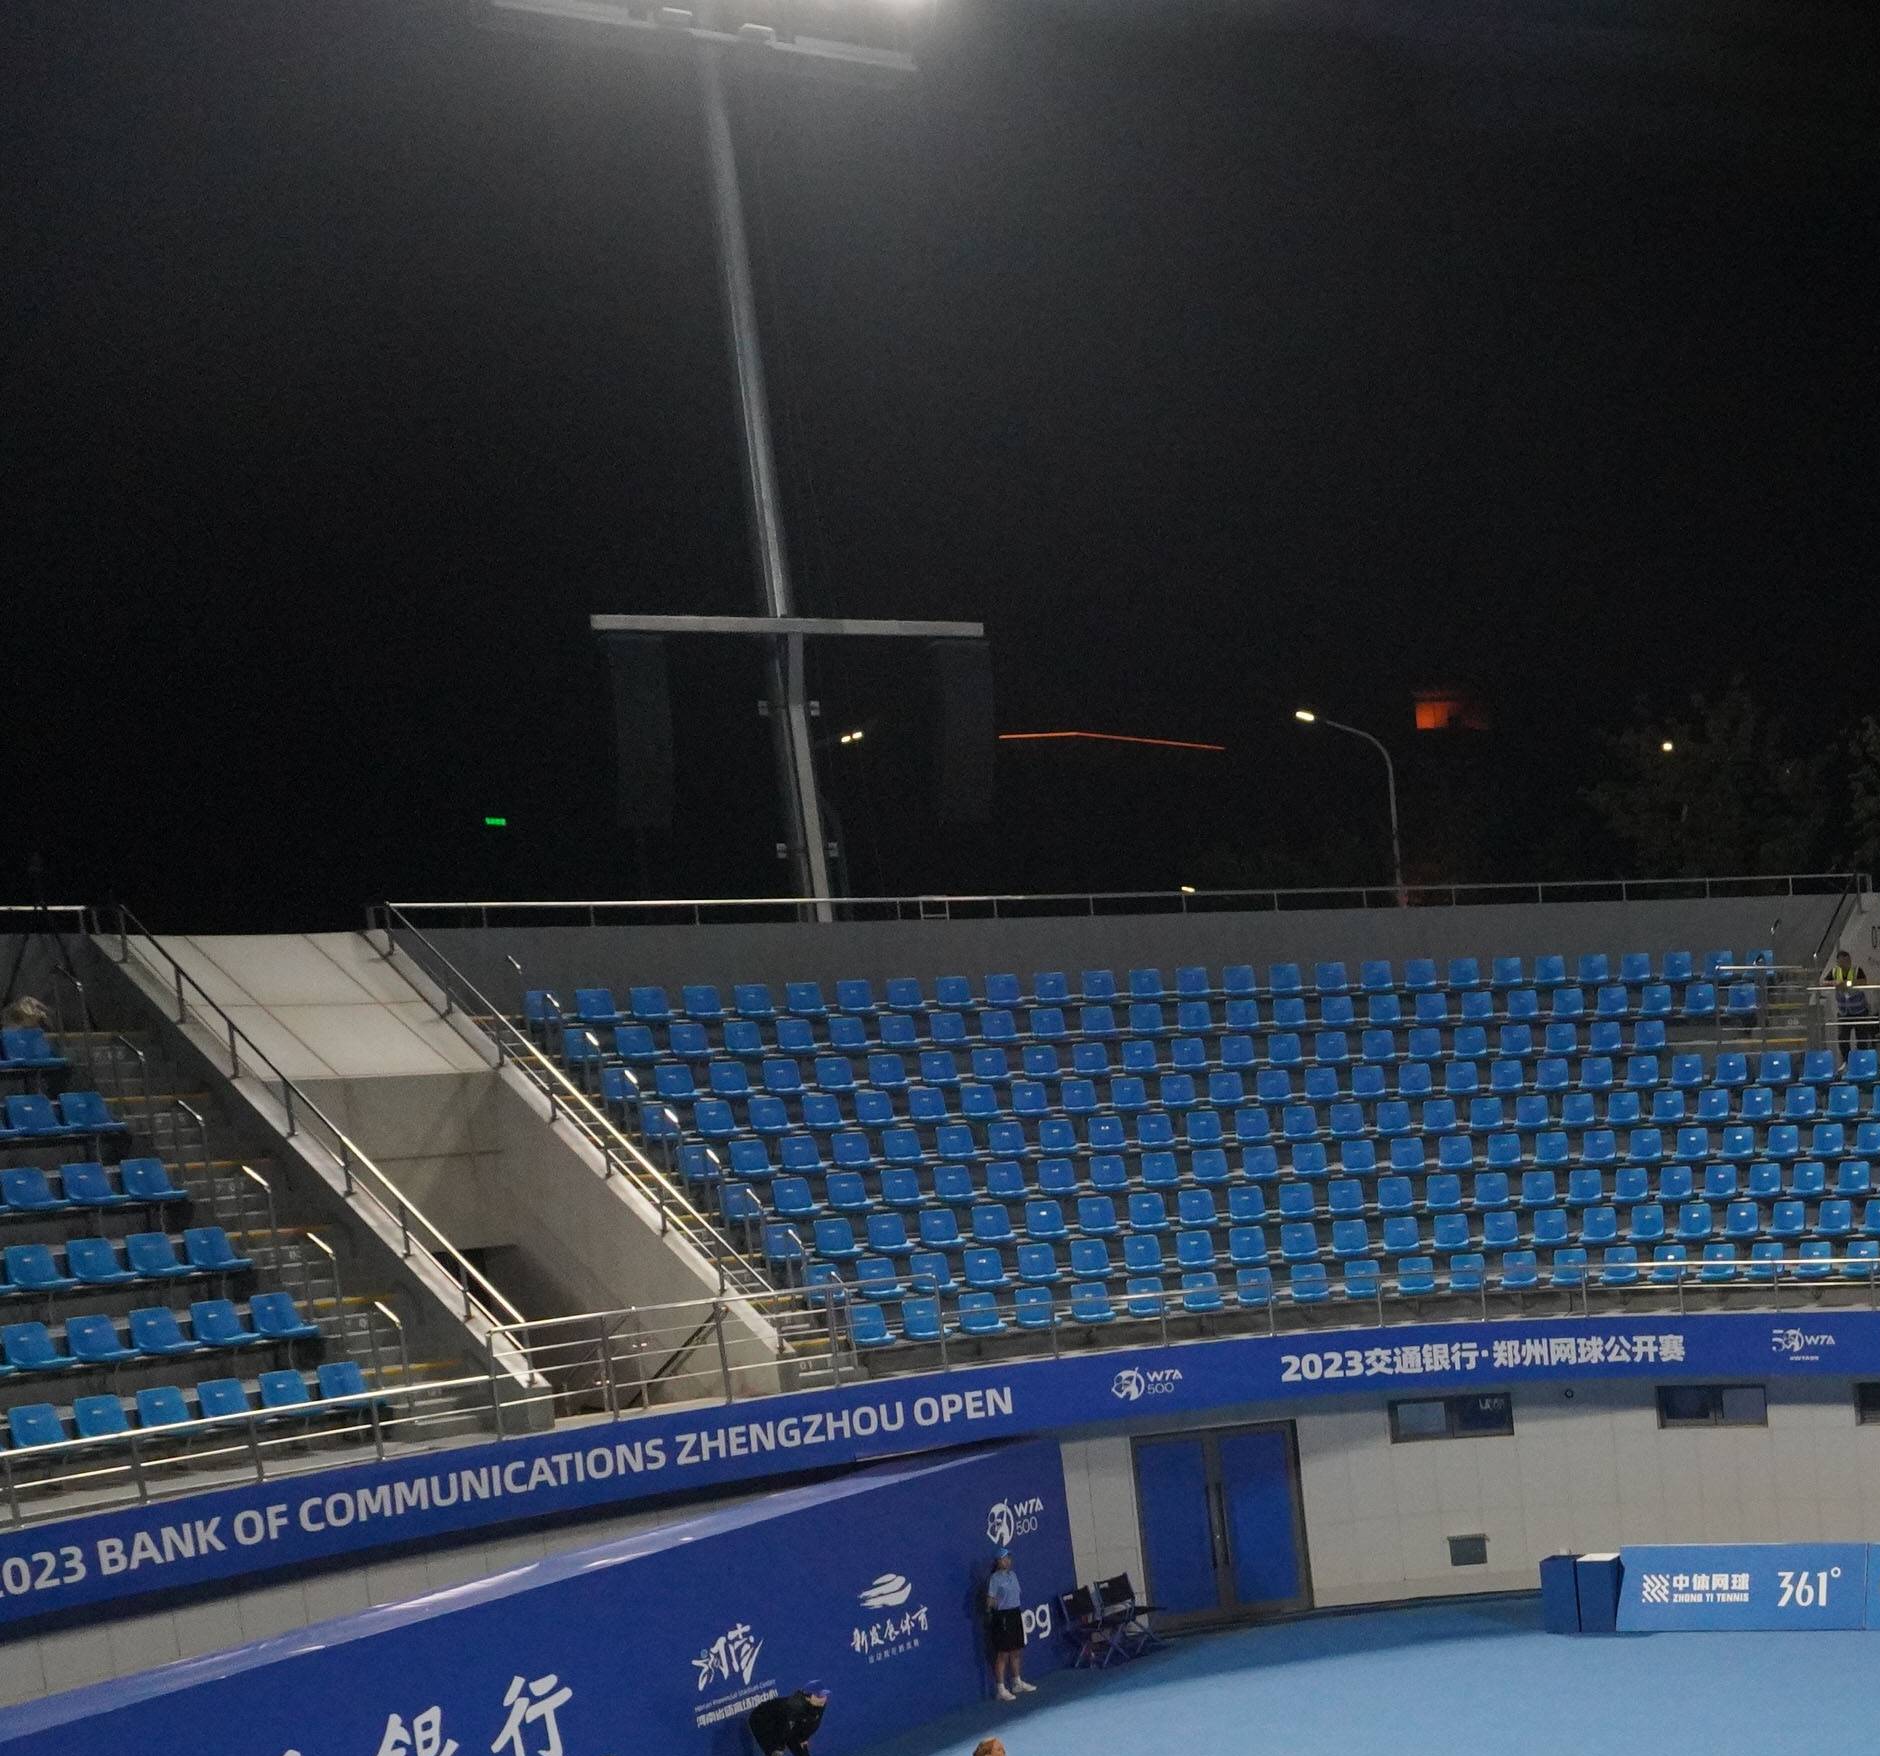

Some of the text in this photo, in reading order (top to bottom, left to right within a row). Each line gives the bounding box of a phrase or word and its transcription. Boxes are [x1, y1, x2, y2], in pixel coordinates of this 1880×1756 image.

[1804, 1334, 1836, 1345] WTA
[1277, 1330, 1686, 1382] 2023交通银行·郑州网球公开赛
[1146, 1369, 1183, 1383] WTA
[1147, 1382, 1175, 1395] 500
[0, 1386, 1013, 1598] 023 BANK OF COMMUNICATIONS ZHENGZHOU OPEN
[1013, 1496, 1044, 1518] WTA
[1016, 1515, 1039, 1536] 500
[1021, 1602, 1051, 1645] pg
